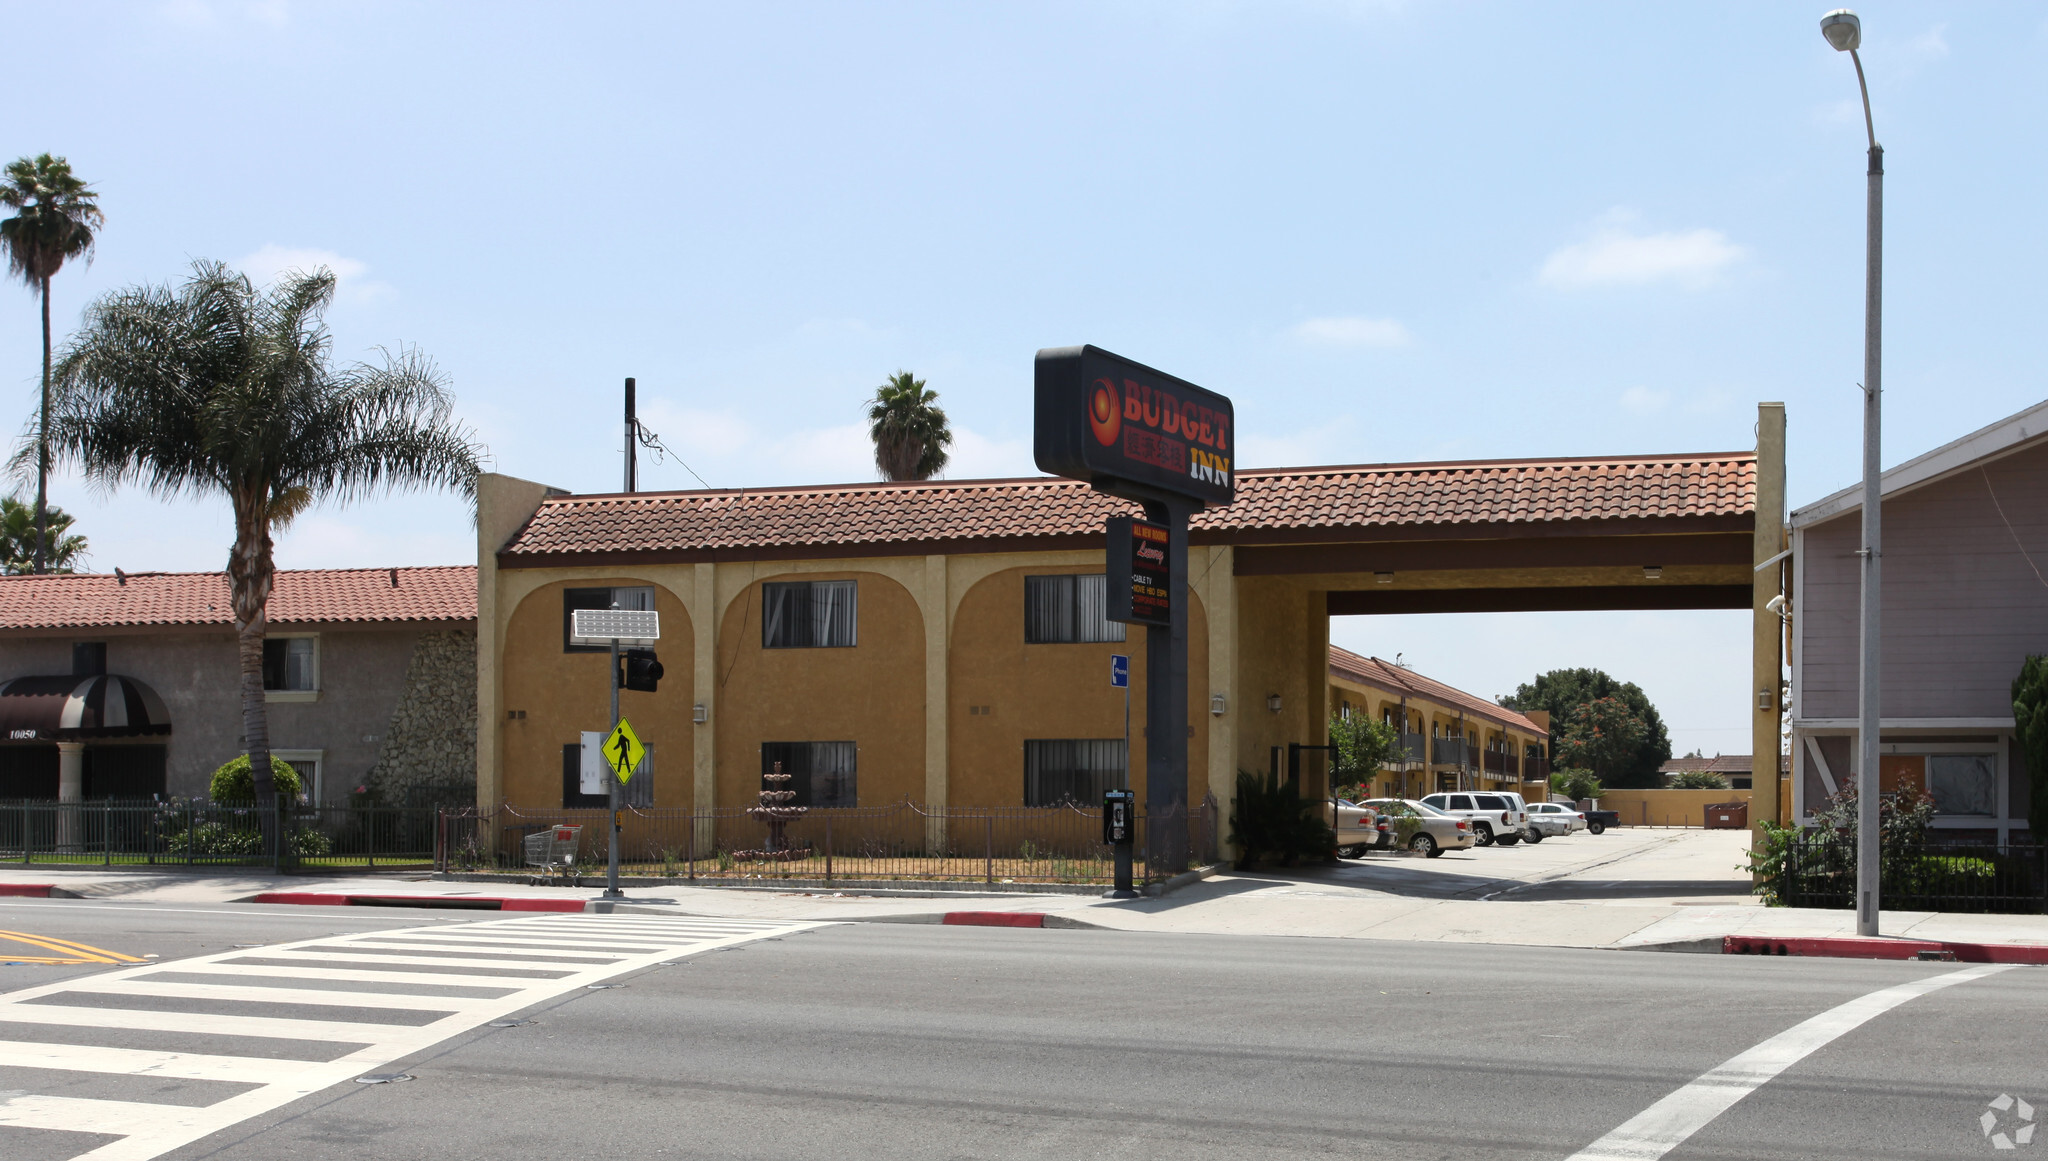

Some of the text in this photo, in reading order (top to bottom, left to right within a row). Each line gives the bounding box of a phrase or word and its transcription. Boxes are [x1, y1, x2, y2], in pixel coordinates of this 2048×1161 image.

[1124, 379, 1229, 450] BUDGET
[1190, 447, 1229, 488] INN
[1142, 527, 1151, 538] NEW
[1152, 529, 1167, 541] ROOMS
[1134, 574, 1152, 585] CABLE TV
[10, 729, 36, 739] 10050
